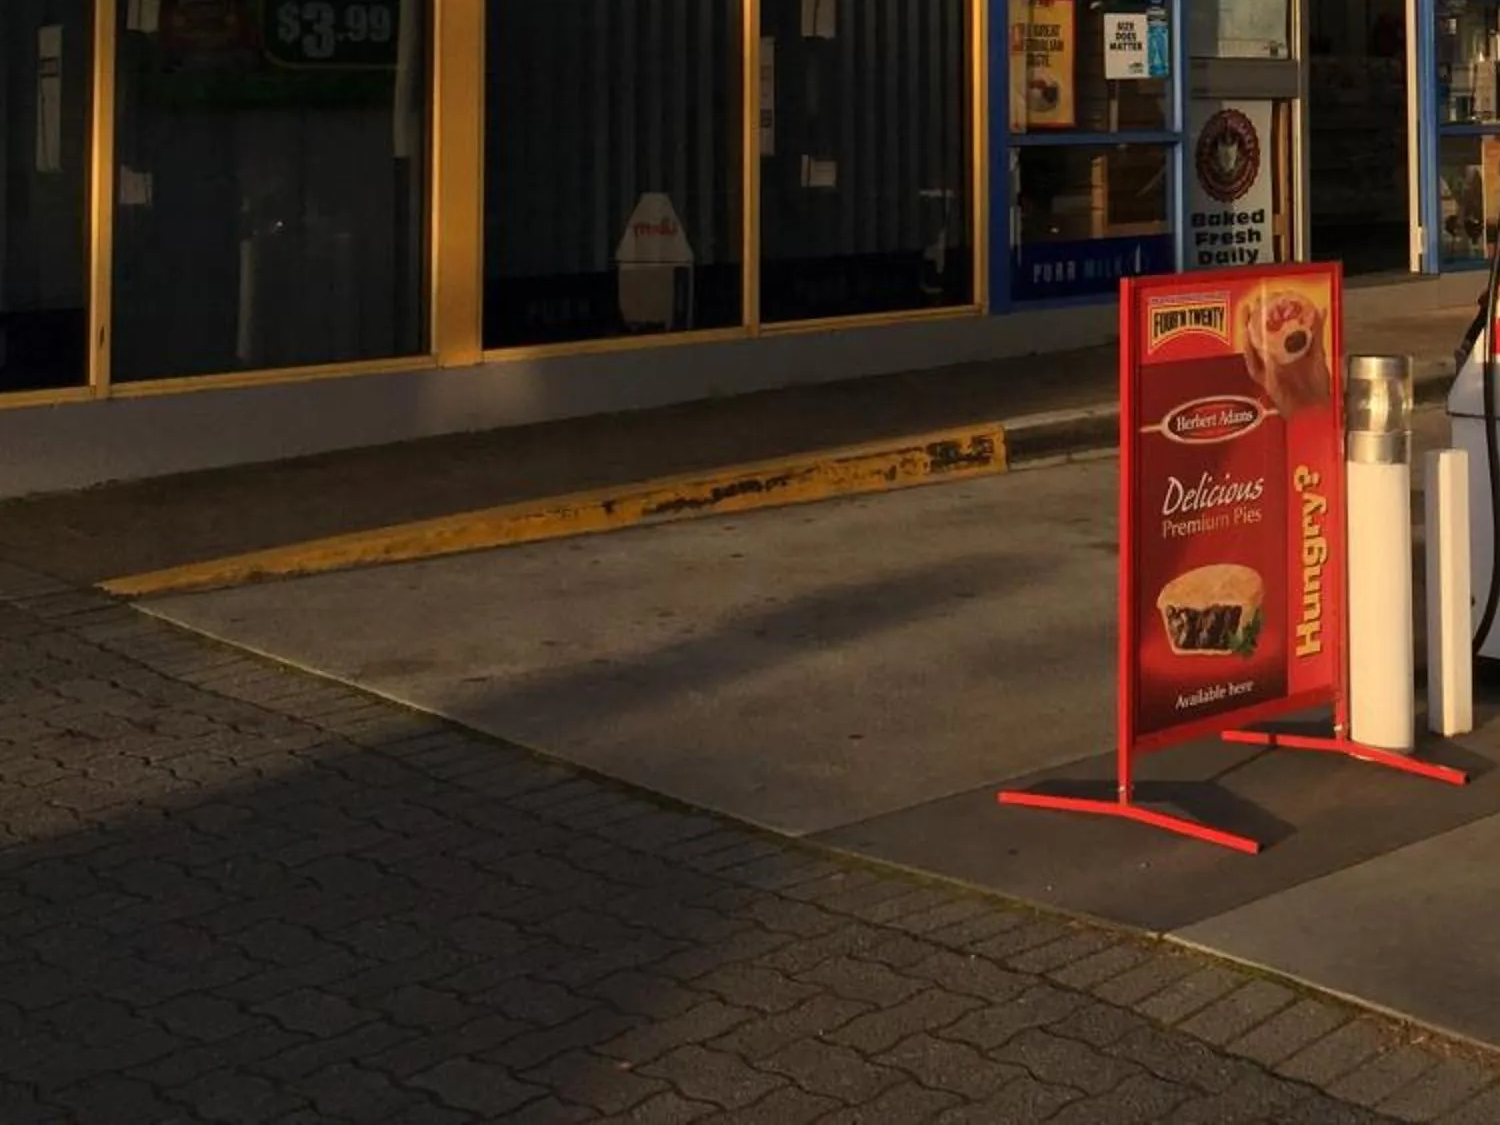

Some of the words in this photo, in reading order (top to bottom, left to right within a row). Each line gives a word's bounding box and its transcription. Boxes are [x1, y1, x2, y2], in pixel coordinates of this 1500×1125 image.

[276, 0, 392, 59] $3.99
[1190, 208, 1266, 228] Baked
[1194, 228, 1262, 247] Fresh
[1197, 247, 1260, 266] Daily
[1176, 412, 1217, 432] Herbert
[1217, 408, 1254, 427] Adams
[1161, 471, 1265, 516] Delicious
[1162, 515, 1230, 539] Premium
[1233, 506, 1263, 526] Pies
[1293, 464, 1329, 658] Hungry?
[1175, 684, 1227, 711] Available
[1228, 681, 1255, 696] here
